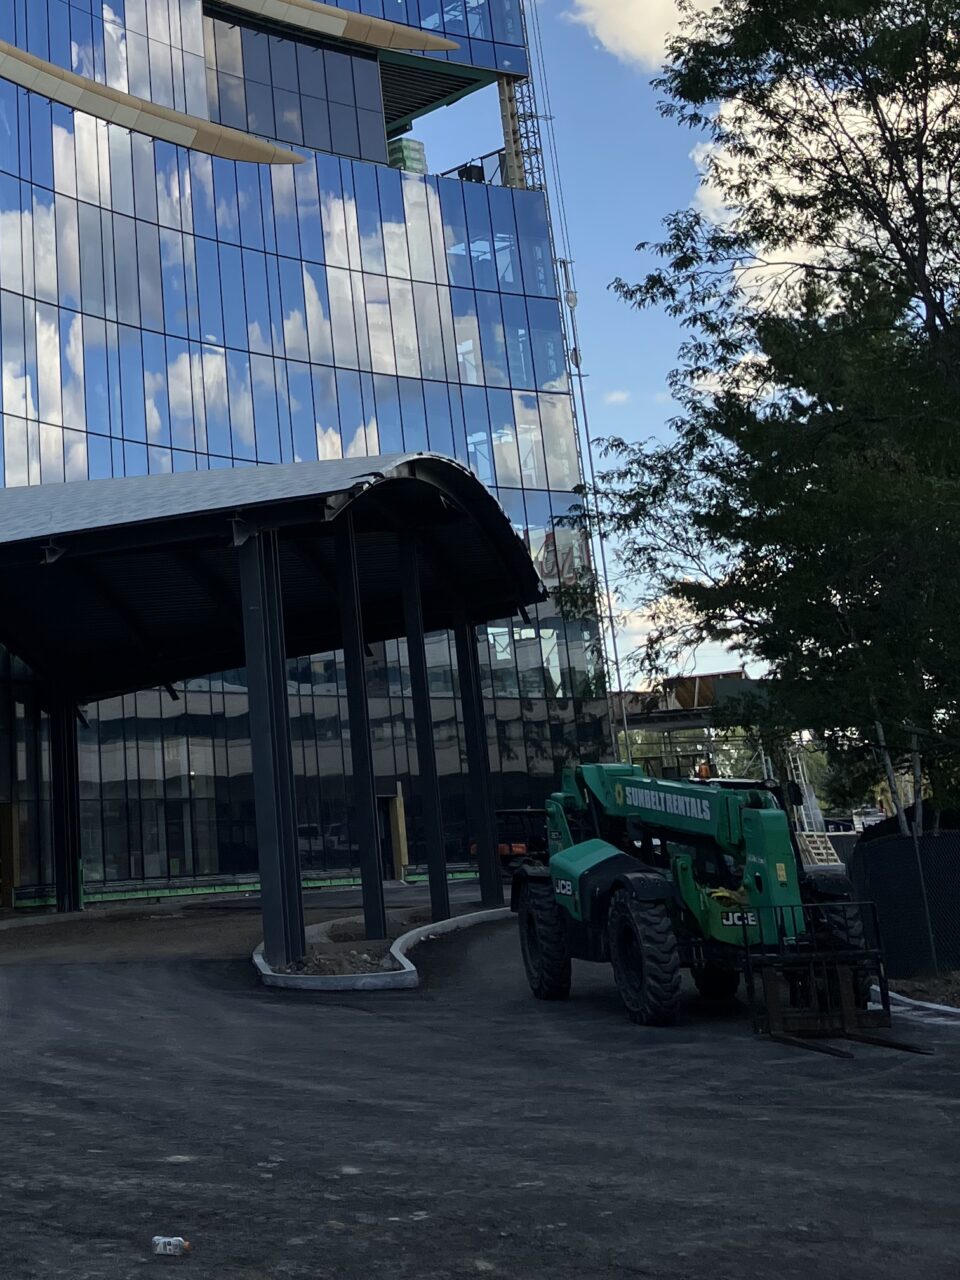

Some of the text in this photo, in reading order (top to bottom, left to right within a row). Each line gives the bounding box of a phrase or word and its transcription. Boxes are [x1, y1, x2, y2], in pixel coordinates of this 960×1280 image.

[625, 787, 710, 820] SUNBELT RENTALS
[555, 879, 572, 895] JCB
